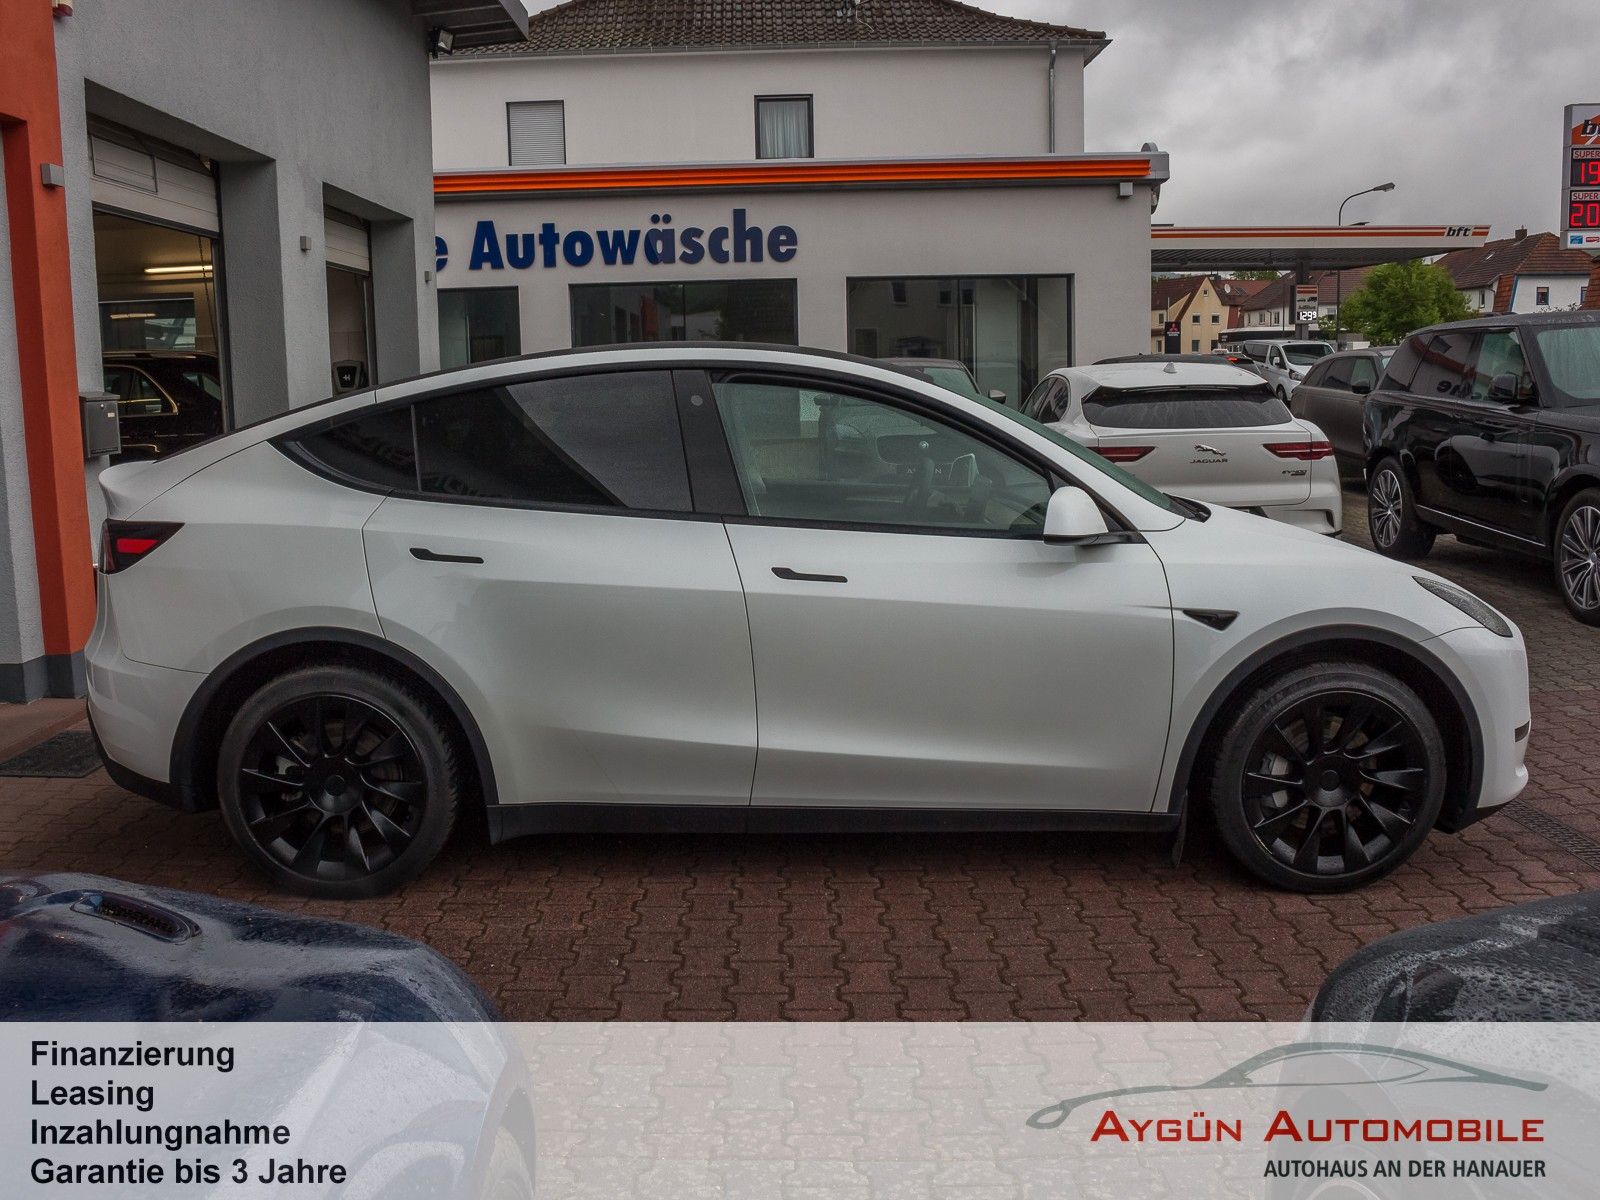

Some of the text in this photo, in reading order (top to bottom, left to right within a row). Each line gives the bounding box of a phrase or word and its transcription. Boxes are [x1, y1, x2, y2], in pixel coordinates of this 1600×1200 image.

[1574, 150, 1600, 158] SUPER
[1570, 203, 1600, 227] 20
[468, 208, 799, 271] Autowäsche
[1446, 226, 1471, 237] bft
